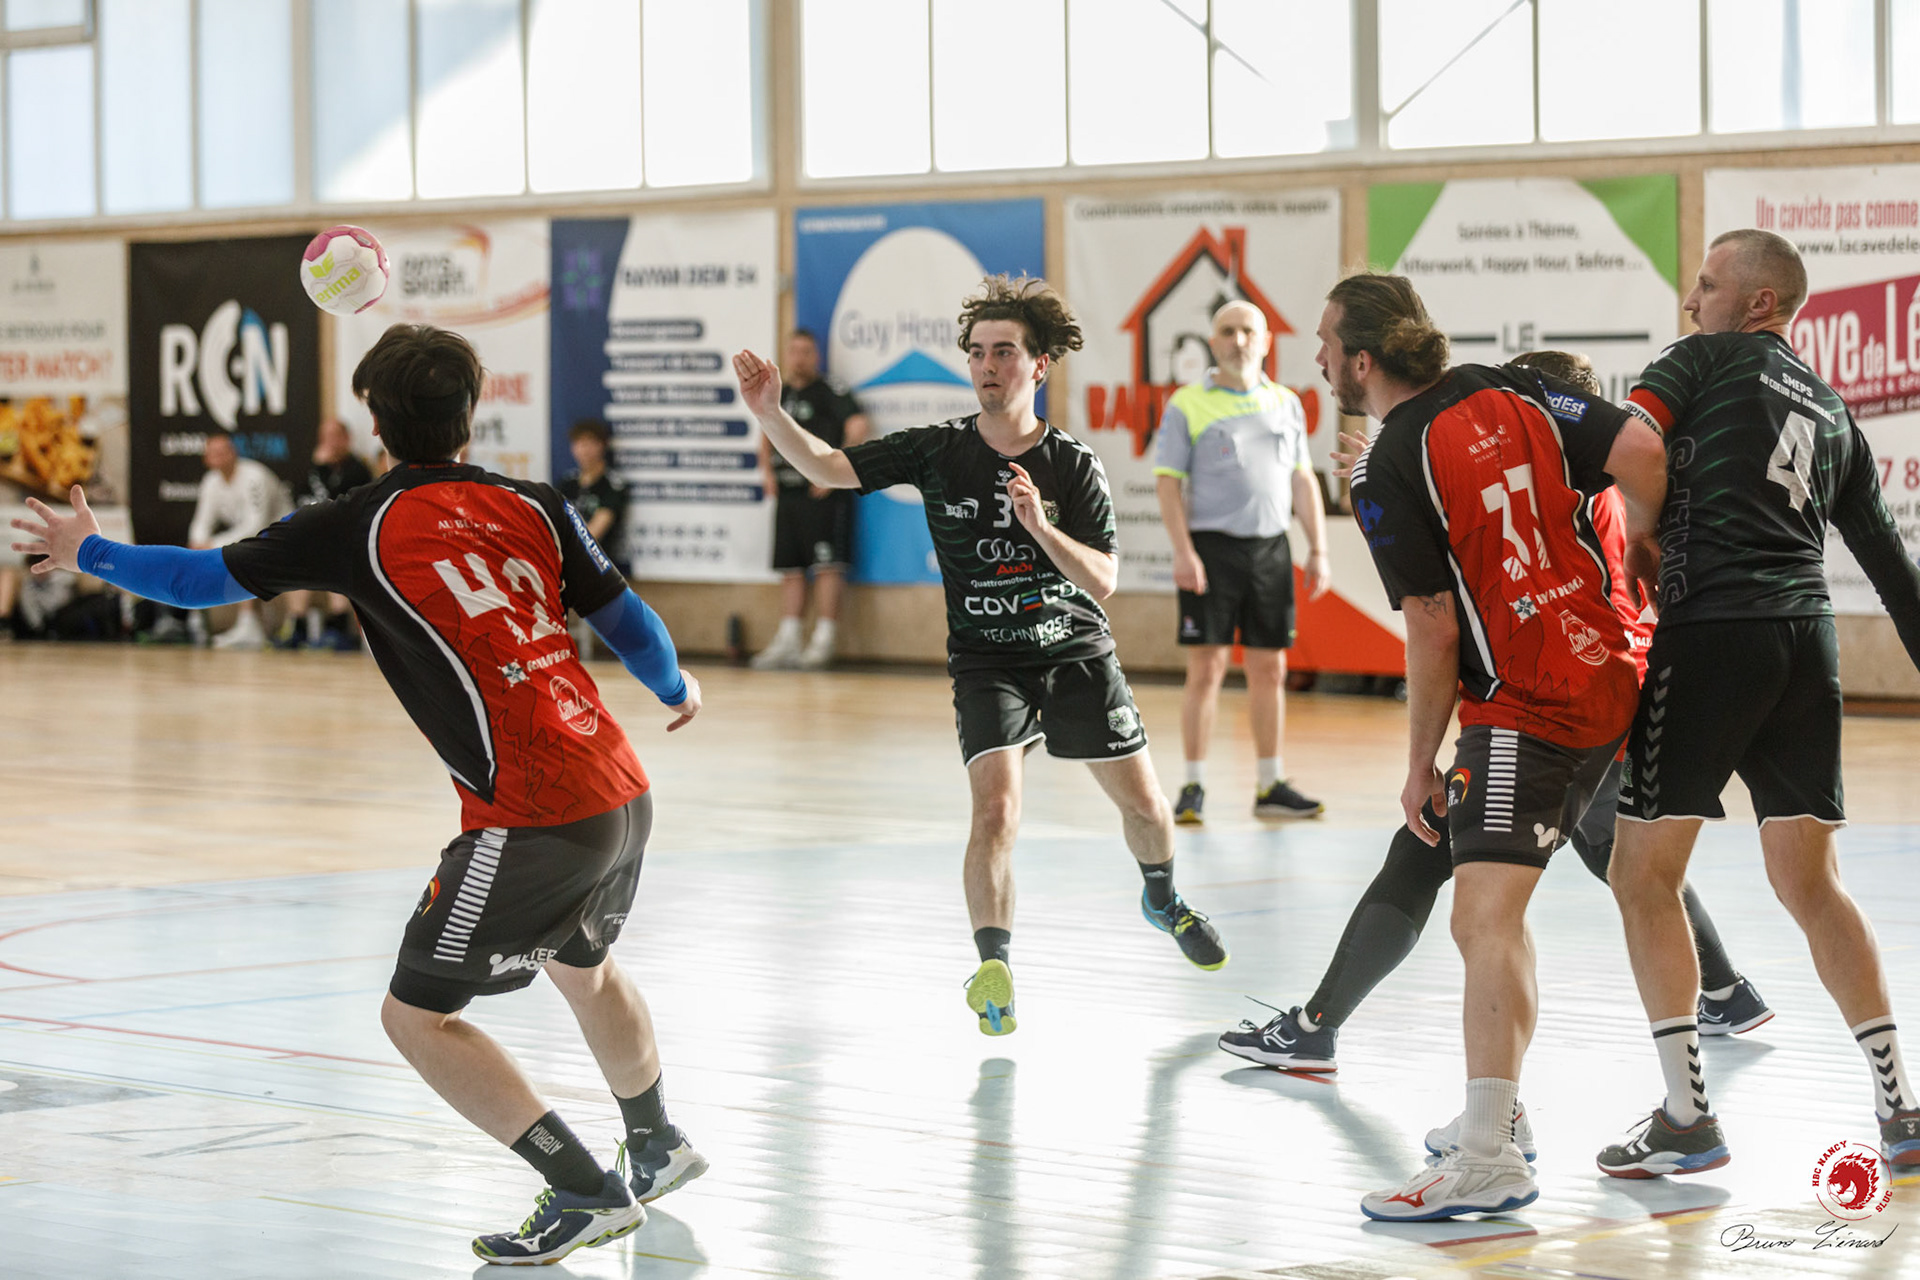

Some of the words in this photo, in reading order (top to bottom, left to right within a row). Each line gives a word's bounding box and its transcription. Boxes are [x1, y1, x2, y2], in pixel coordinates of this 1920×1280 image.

[1755, 196, 1775, 229] Un
[1779, 194, 1832, 231] caviste
[1835, 202, 1861, 233] pas
[1865, 199, 1919, 228] comme
[1482, 253, 1529, 274] Happy
[315, 266, 361, 303] erima
[839, 309, 889, 357] Guy
[1503, 323, 1535, 352] LE
[1793, 310, 1860, 385] ave
[1862, 332, 1886, 381] de
[1759, 372, 1769, 385] AU
[1802, 397, 1837, 426] HANDBALL
[1781, 372, 1814, 398] SMEPS
[1766, 410, 1817, 514] 4
[970, 574, 1033, 589] Quattromotors
[995, 562, 1034, 576] Audi
[431, 551, 569, 646] 42
[1039, 626, 1074, 649] NANCY
